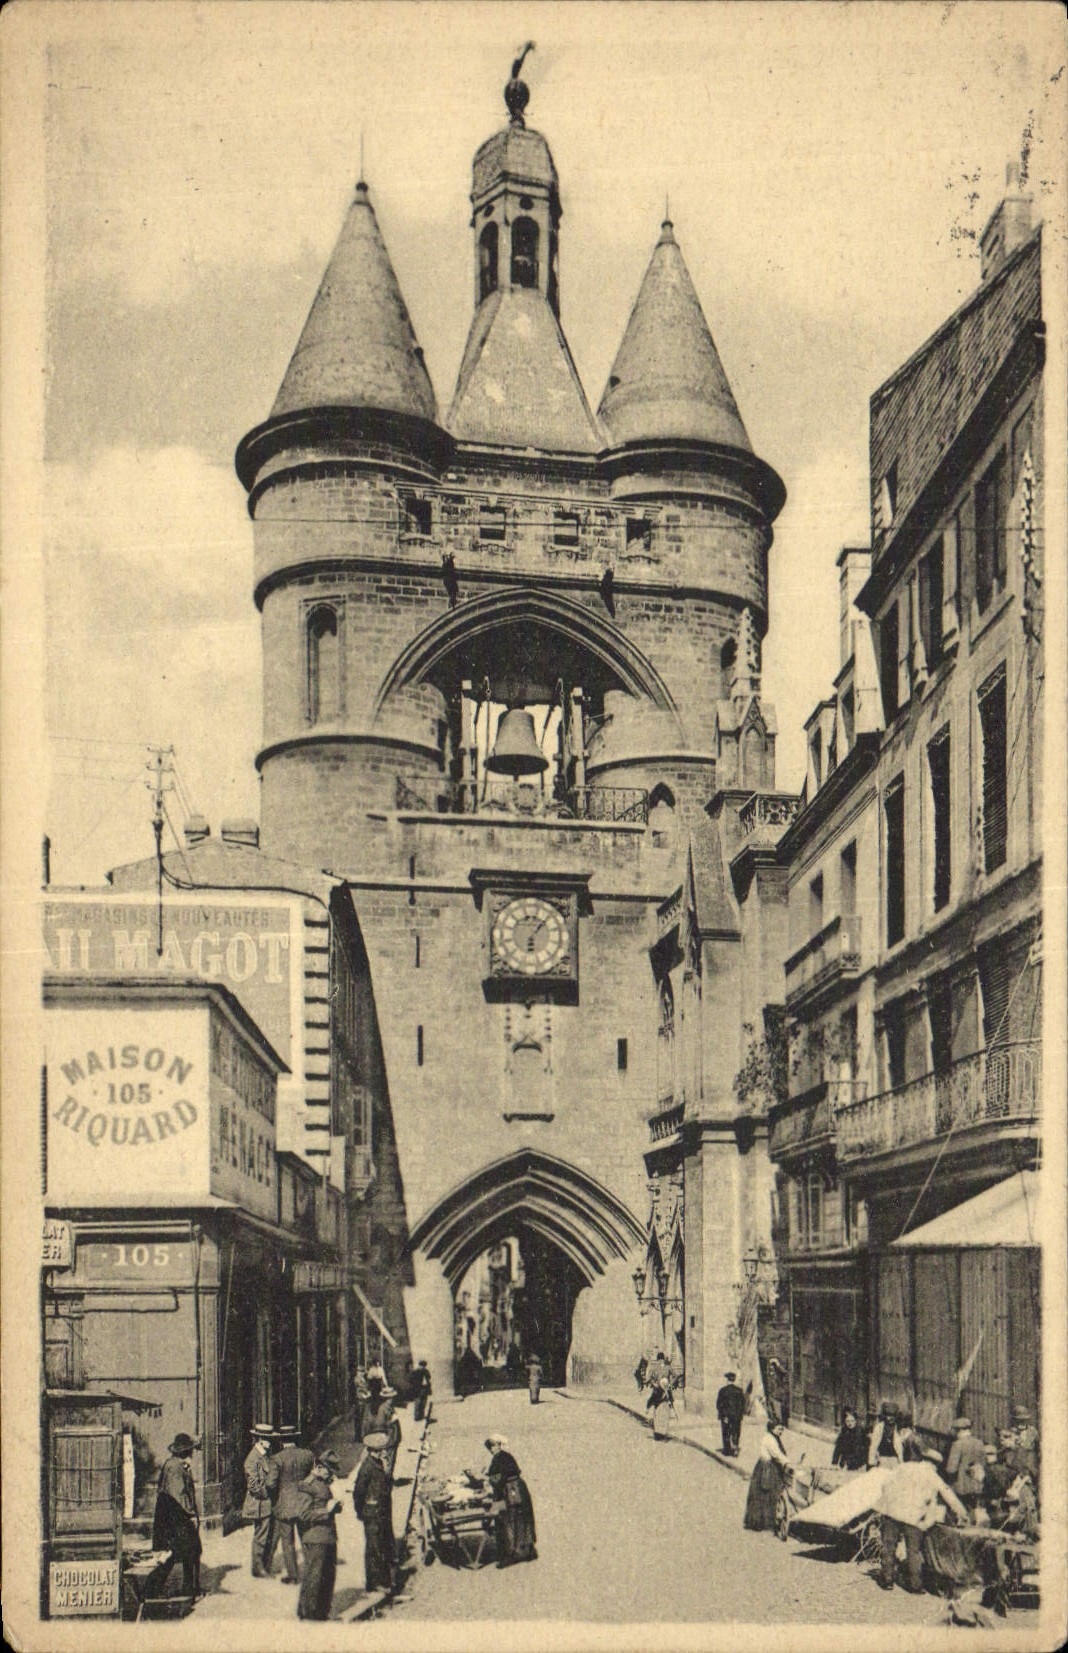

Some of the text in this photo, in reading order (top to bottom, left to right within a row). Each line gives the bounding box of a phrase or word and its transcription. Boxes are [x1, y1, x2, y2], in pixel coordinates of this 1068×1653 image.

[113, 929, 289, 983] MAGOT
[61, 1045, 193, 1085] MAISON
[108, 1083, 151, 1104] 105
[53, 1096, 198, 1147] RIQUARD
[115, 1246, 169, 1266] 105
[54, 1569, 116, 1587] CHOCOLAT
[57, 1589, 112, 1608] MENIER
